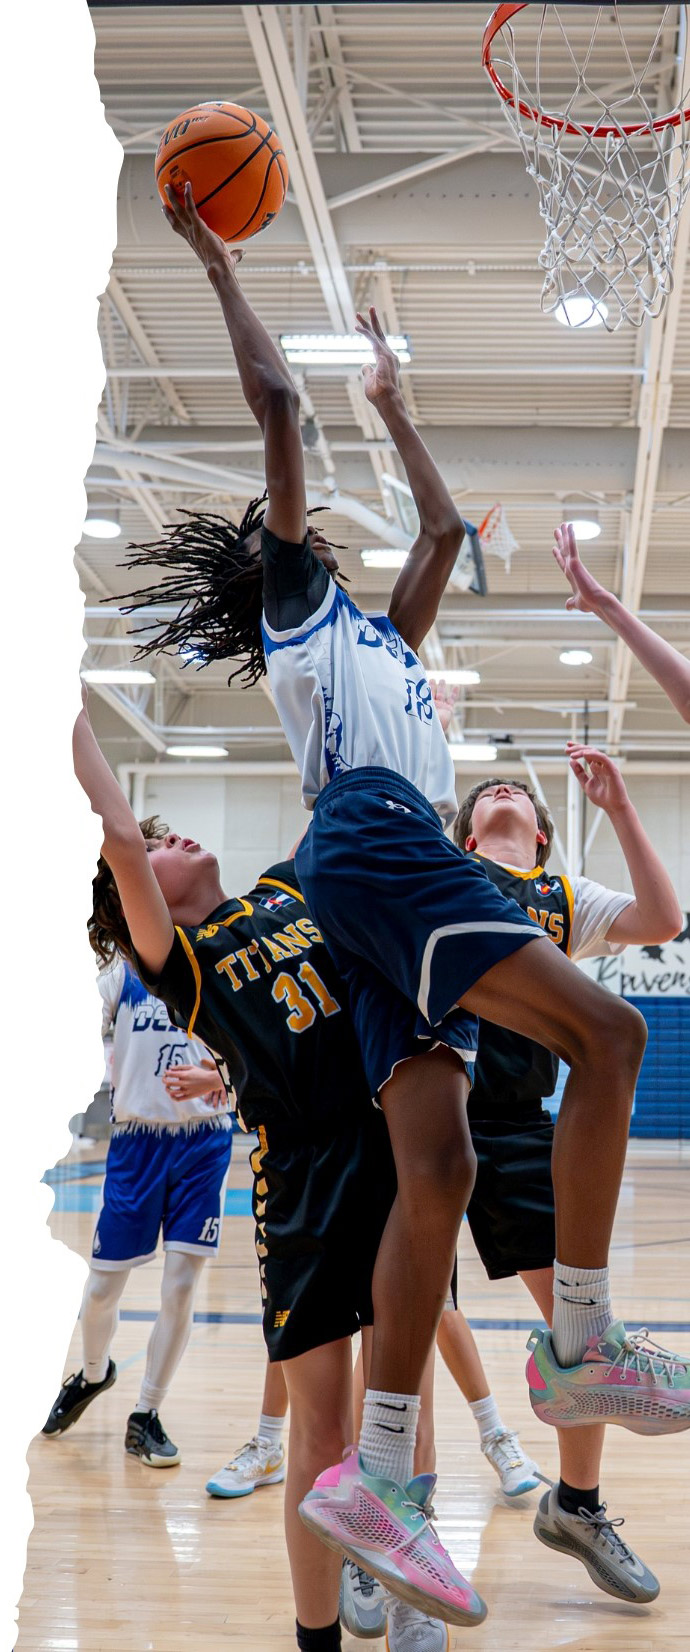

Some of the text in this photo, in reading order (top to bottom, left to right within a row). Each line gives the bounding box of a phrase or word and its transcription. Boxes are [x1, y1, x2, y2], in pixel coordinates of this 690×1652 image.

[593, 956, 690, 995] Raven
[271, 961, 342, 1034] 31
[132, 1004, 178, 1032] DE
[154, 1043, 188, 1077] 15
[198, 1216, 220, 1242] 15
